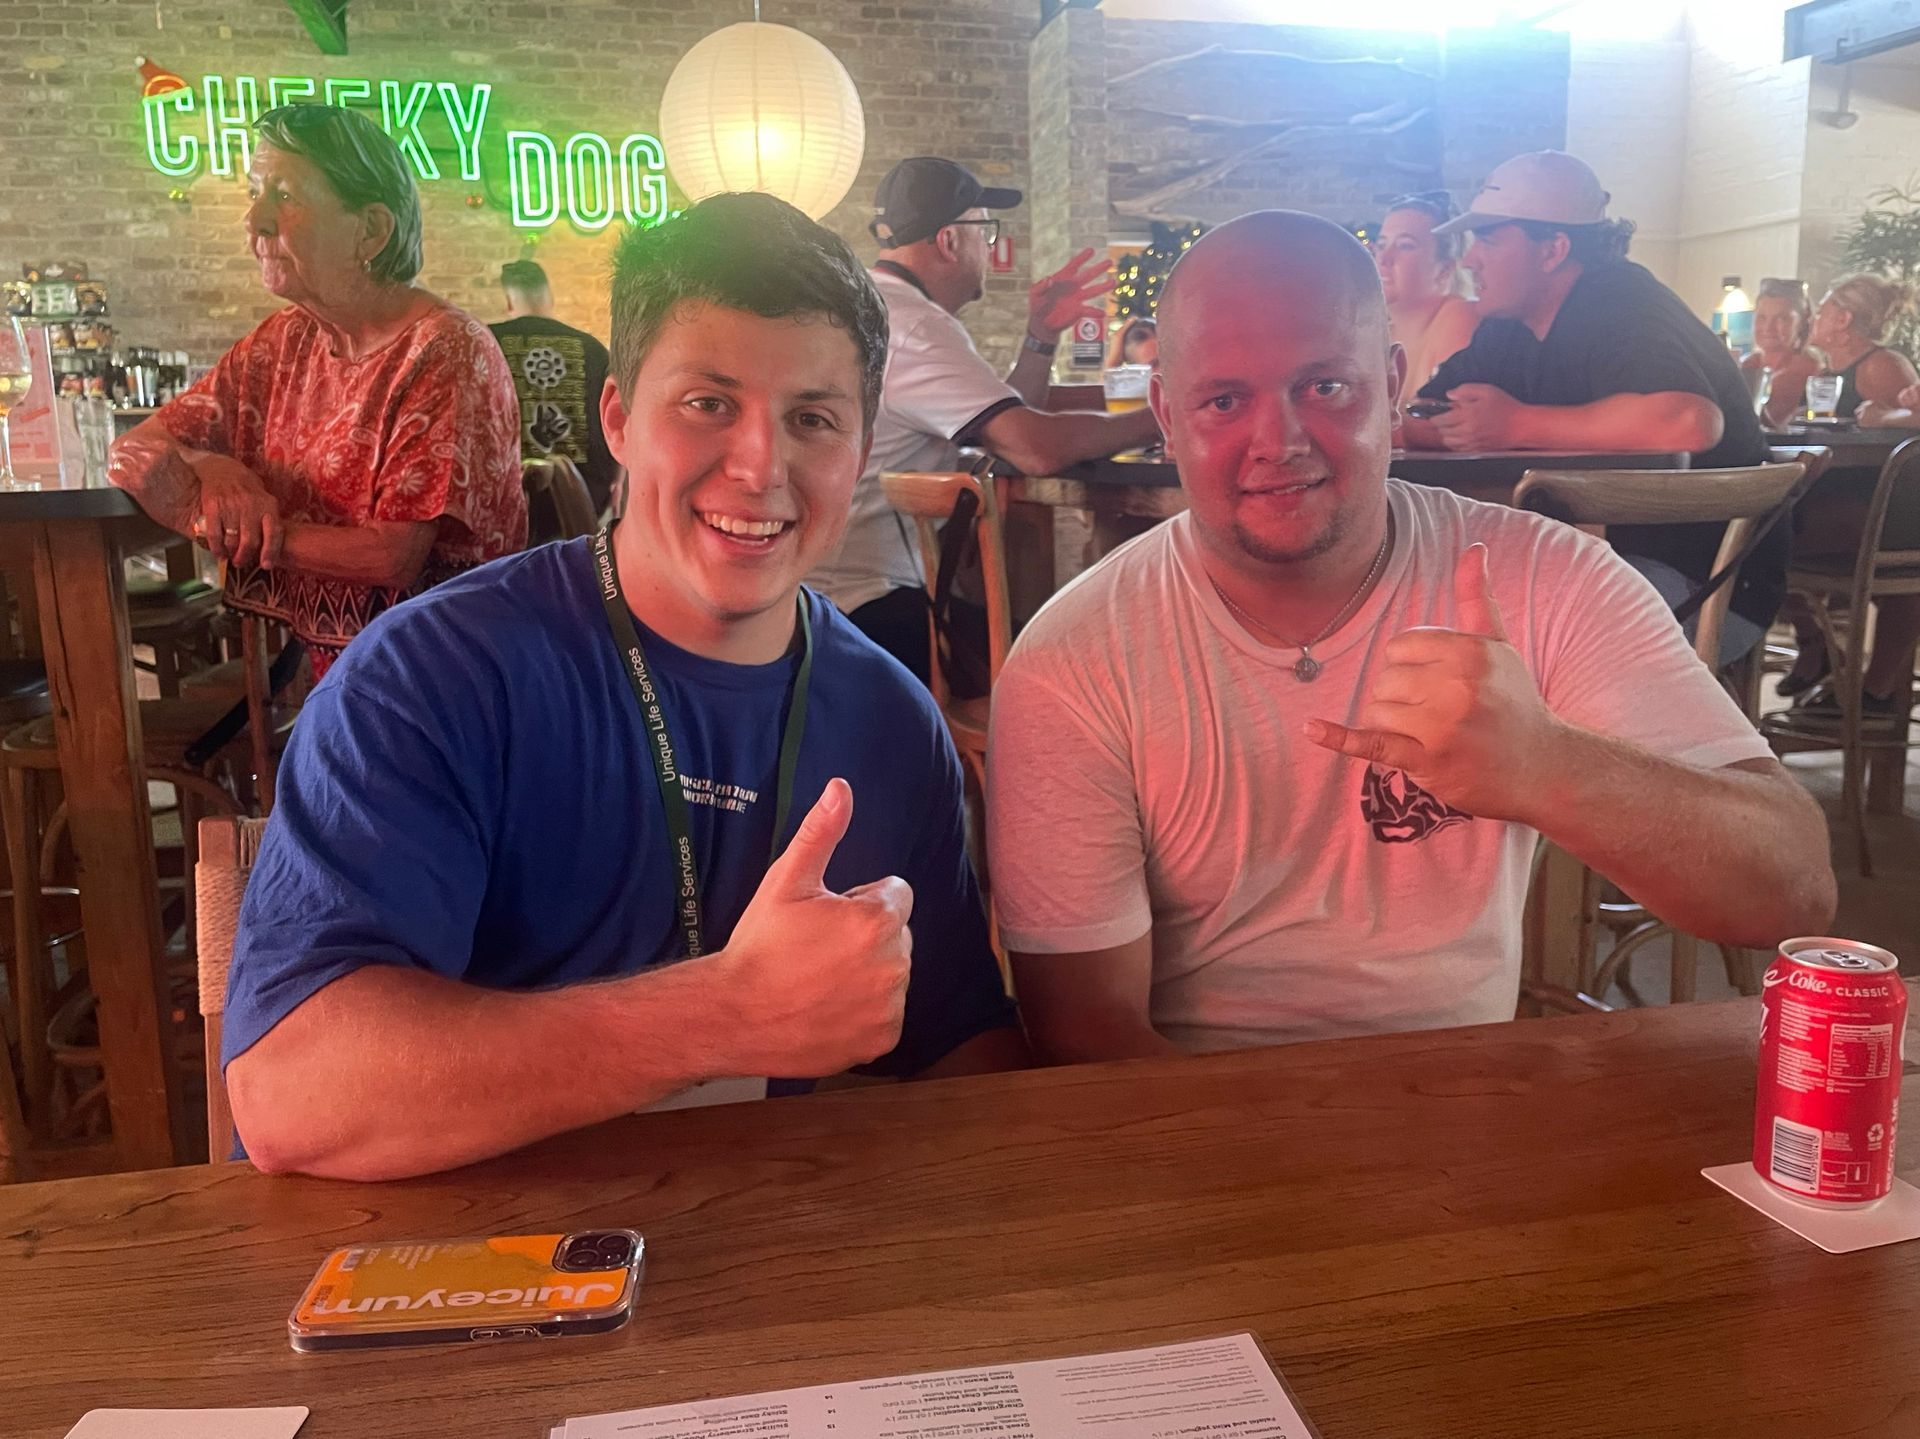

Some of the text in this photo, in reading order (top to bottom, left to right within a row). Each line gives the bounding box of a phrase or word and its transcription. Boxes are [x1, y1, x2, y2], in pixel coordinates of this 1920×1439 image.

[142, 75, 492, 181] CHKY
[599, 556, 618, 600] Unique
[629, 647, 676, 782] Unique Life Services
[679, 836, 695, 897] Services
[684, 902, 698, 927] Life
[1788, 970, 1827, 993] Coke
[1836, 986, 1889, 998] CLASSIC
[312, 1282, 615, 1316] Juiceyum
[979, 1425, 1004, 1433] Salad
[1179, 1425, 1210, 1434] yoghurt
